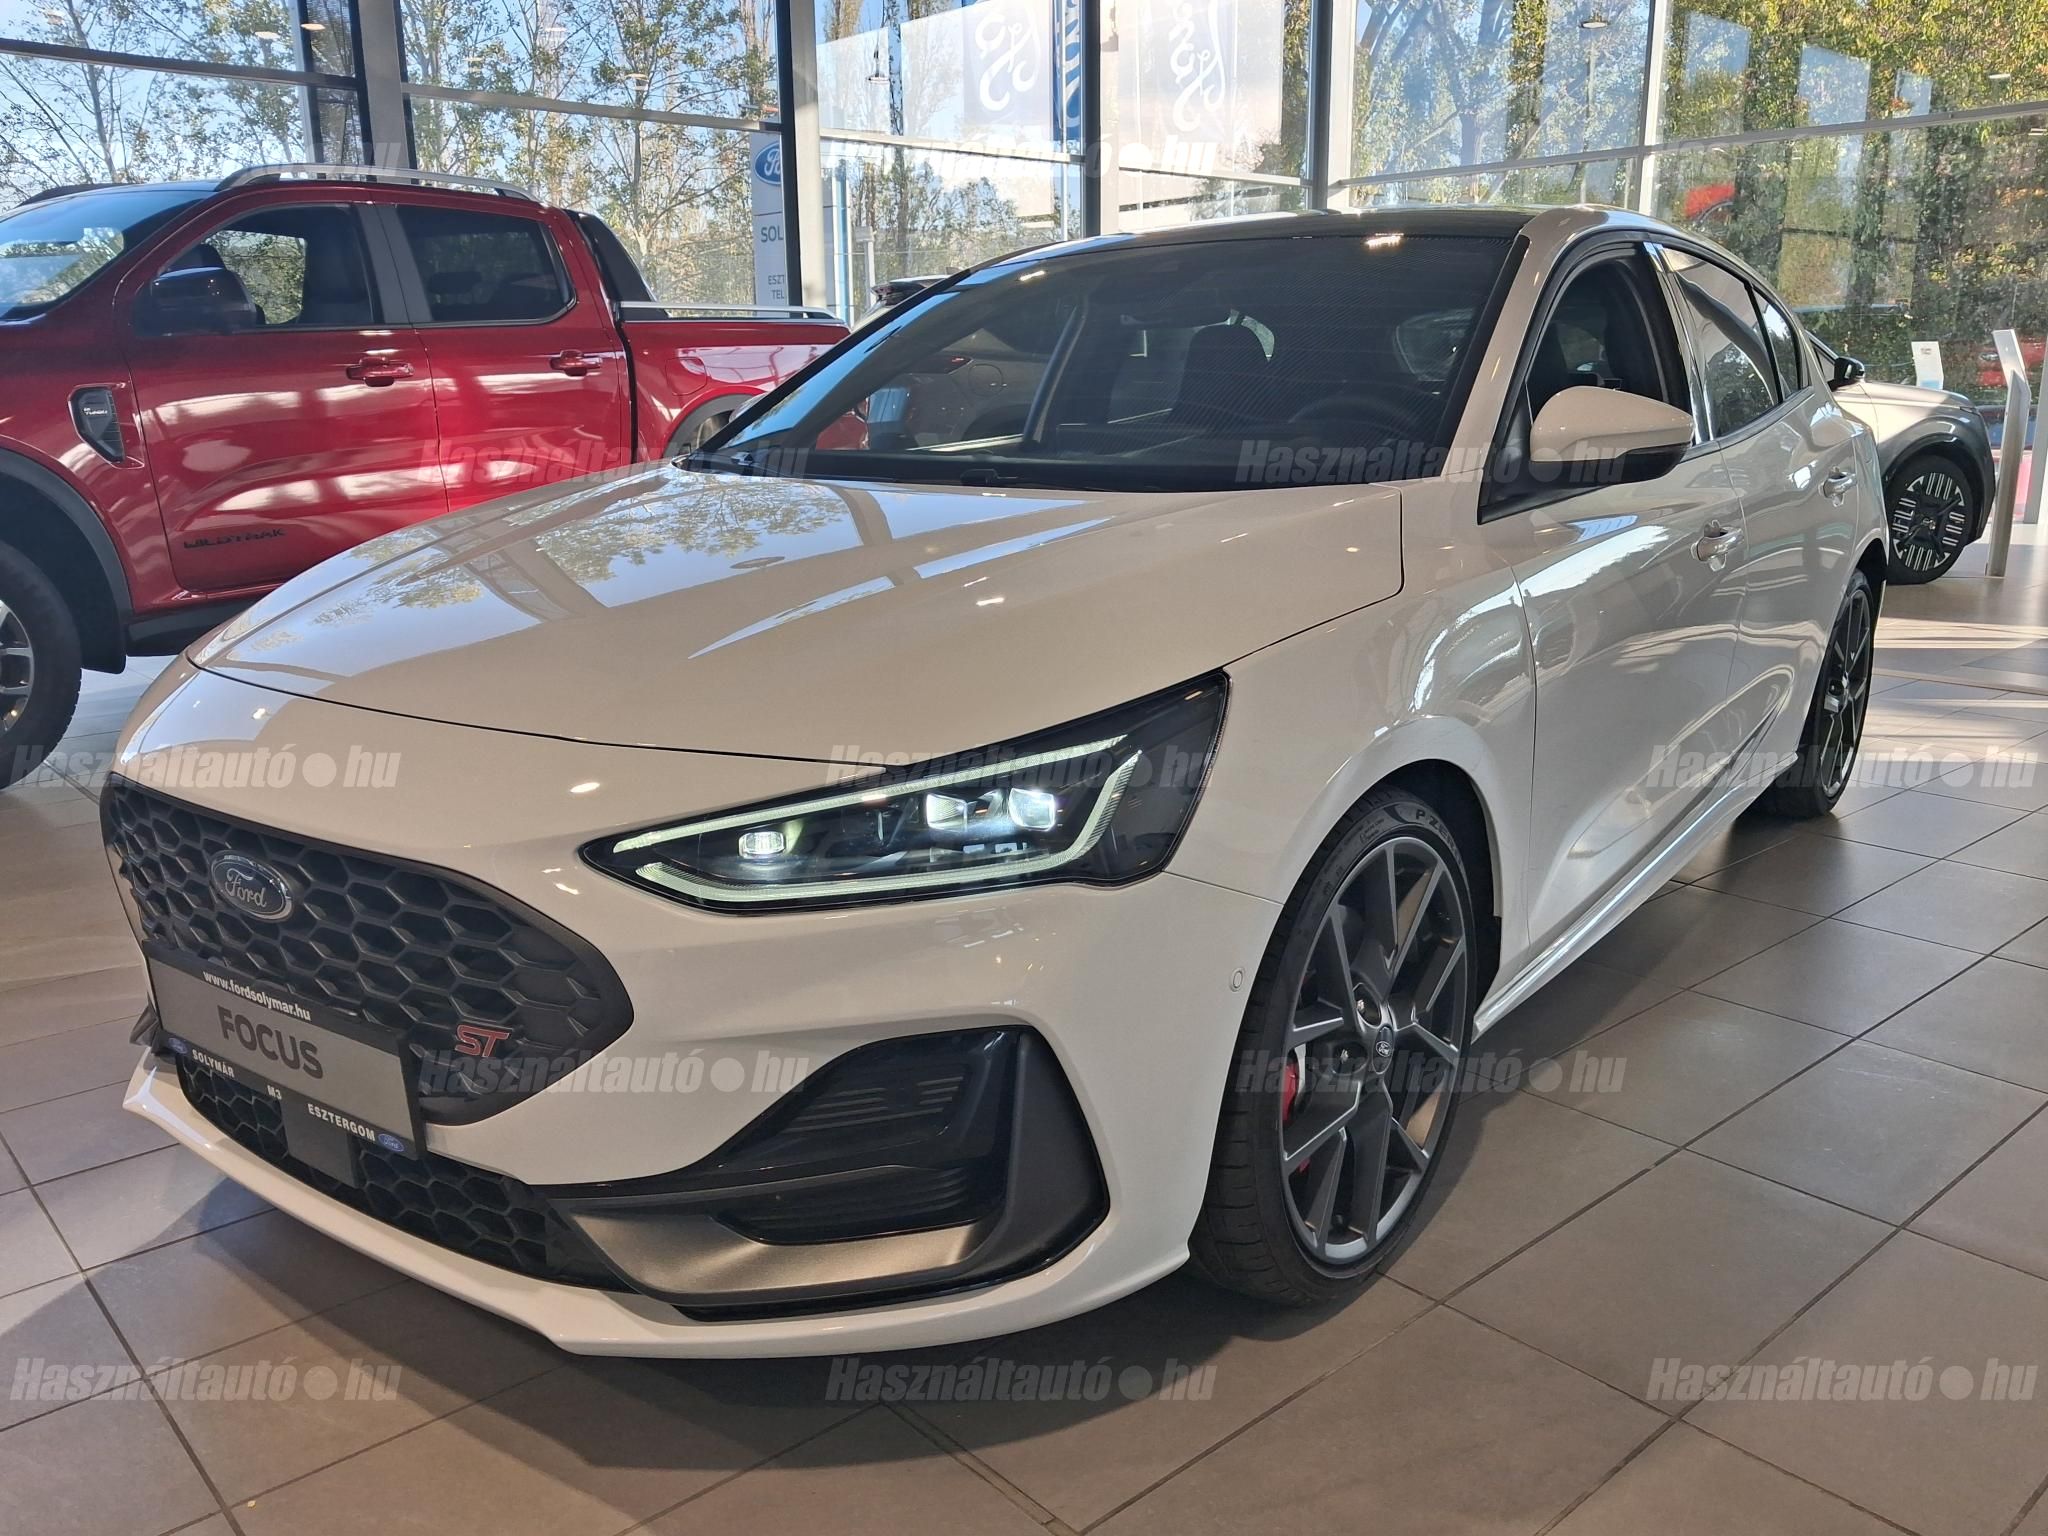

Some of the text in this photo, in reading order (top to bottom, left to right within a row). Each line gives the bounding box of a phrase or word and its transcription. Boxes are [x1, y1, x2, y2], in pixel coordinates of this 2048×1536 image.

[224, 866, 267, 907] Ford
[202, 971, 311, 1021] www.fordsolymar.hu
[217, 1004, 323, 1079] FOCUS
[454, 1024, 510, 1058] ST
[192, 1049, 235, 1079] SOLYMÁR
[307, 1103, 376, 1143] ESZTERGOM
